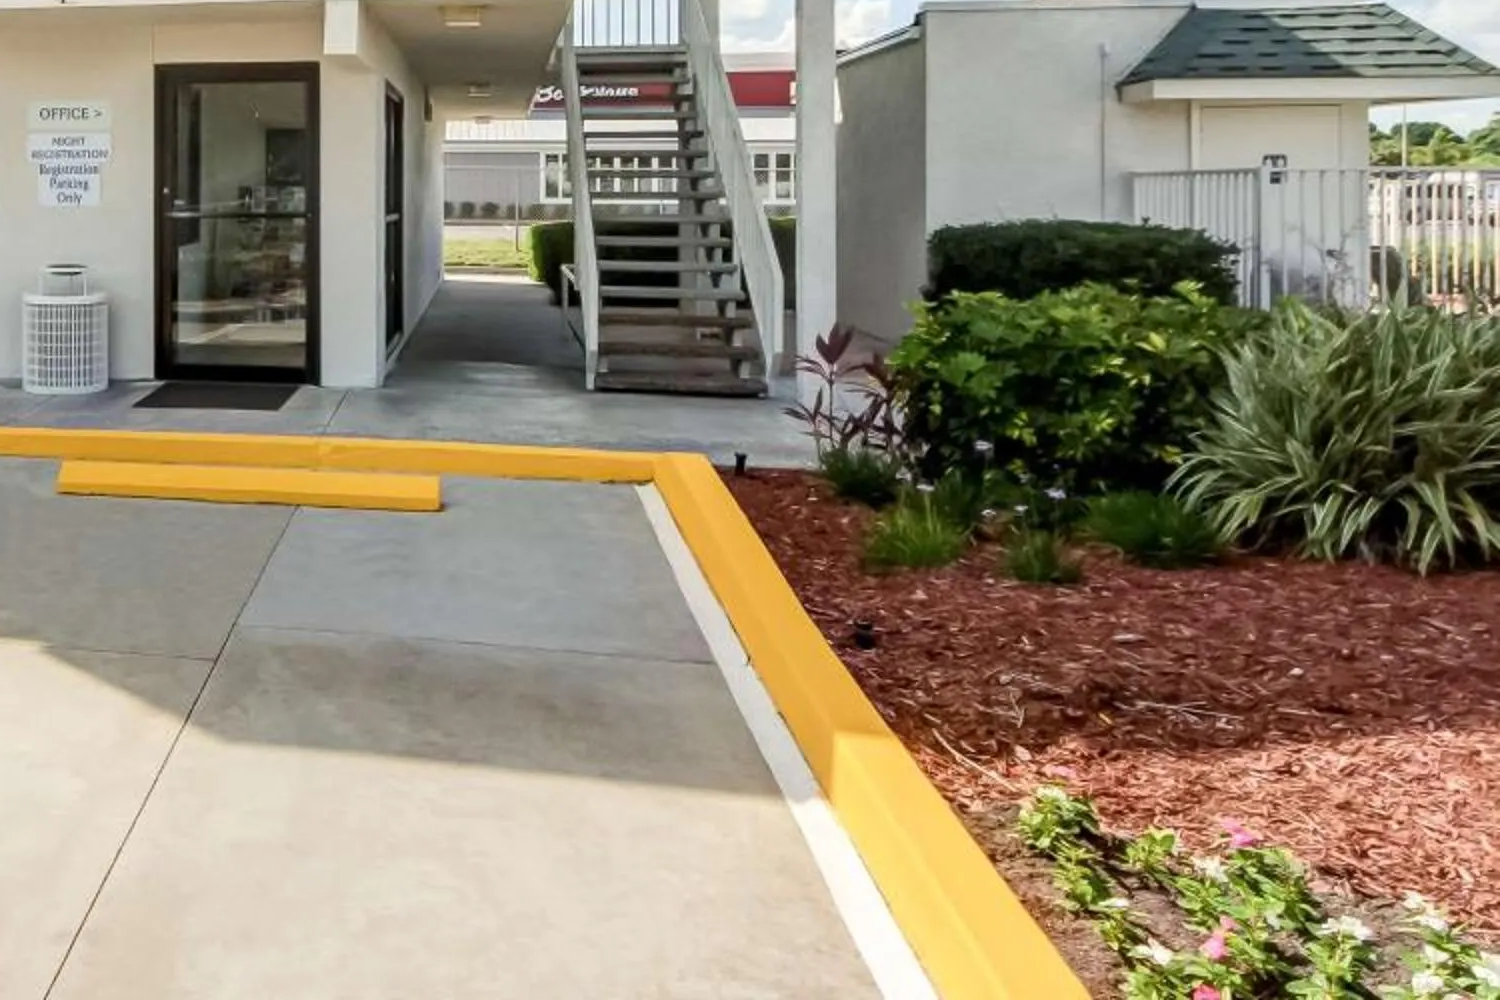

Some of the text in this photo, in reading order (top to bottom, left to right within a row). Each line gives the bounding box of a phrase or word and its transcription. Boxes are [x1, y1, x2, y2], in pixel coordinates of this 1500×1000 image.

[39, 107, 89, 120] OFFICE
[51, 136, 85, 146] NIGHT
[31, 149, 109, 159] REGISTRATION
[50, 178, 89, 192] Parking
[56, 192, 83, 205] Only
